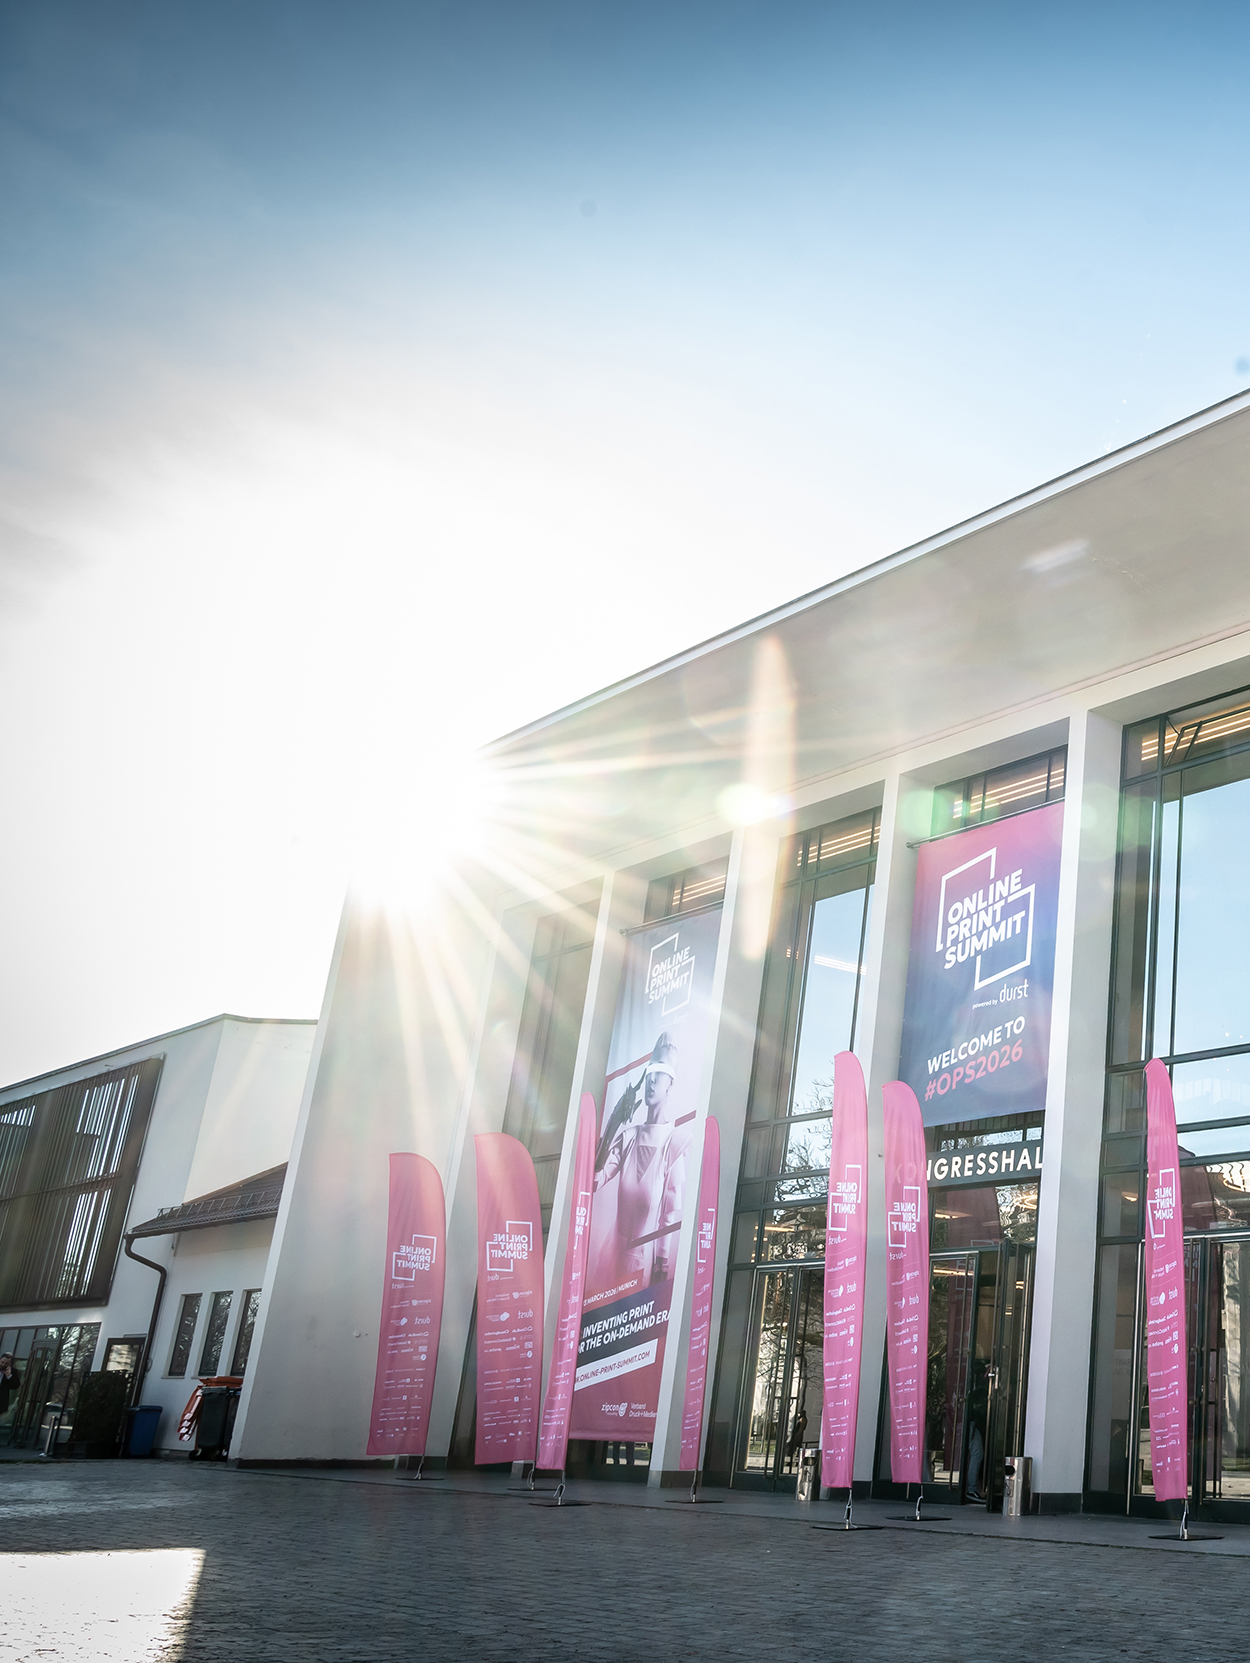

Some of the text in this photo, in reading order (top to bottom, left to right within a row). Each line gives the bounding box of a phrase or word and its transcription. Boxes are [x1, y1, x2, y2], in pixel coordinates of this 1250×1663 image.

[947, 868, 1023, 925] ONLINE
[943, 910, 1026, 970] SUMMIT
[946, 899, 1006, 949] PRINT
[650, 964, 681, 991] PRINT
[651, 946, 691, 978] ONLINE
[648, 971, 690, 1005] SUMMIT
[999, 978, 1029, 1003] durst
[927, 1015, 1025, 1076] WELCOME TO
[924, 1038, 1024, 1102] #OPS2026
[585, 1293, 605, 1305] MARCH
[618, 1278, 638, 1292] MUNICH
[628, 1300, 655, 1321] PRINT
[585, 1336, 602, 1352] THE
[603, 1316, 656, 1345] ON-DEMAND
[601, 1401, 619, 1413] zipcon
